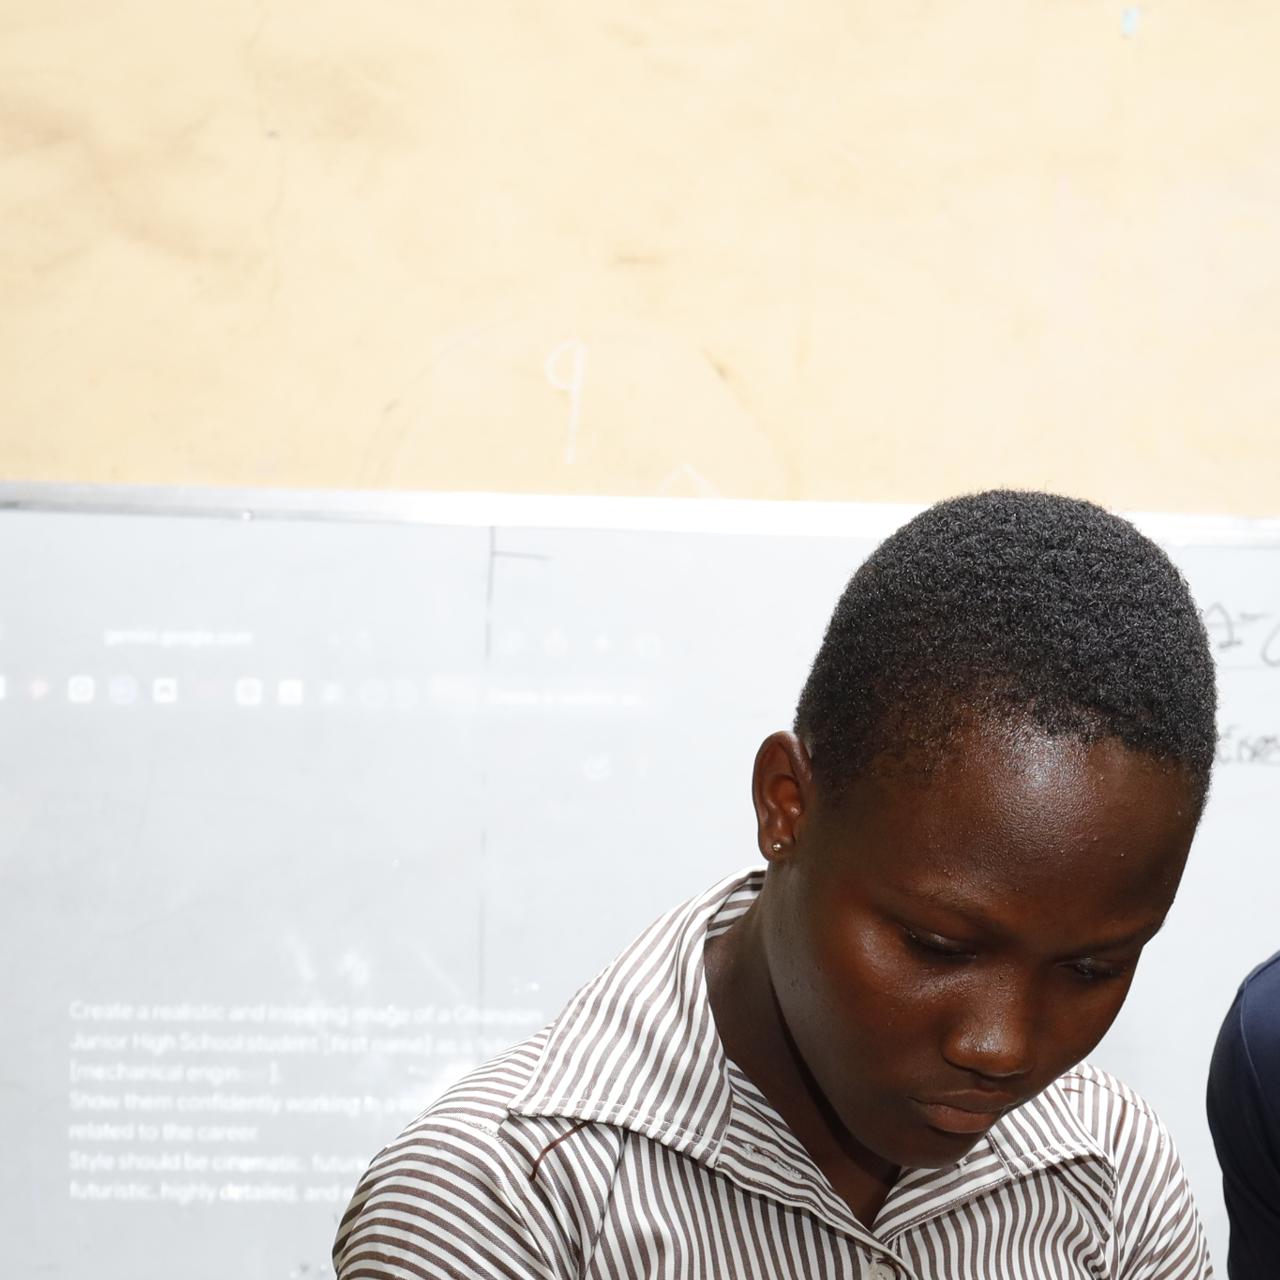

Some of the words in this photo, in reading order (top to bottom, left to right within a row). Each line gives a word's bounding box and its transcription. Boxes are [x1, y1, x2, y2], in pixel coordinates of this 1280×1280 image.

[69, 1000, 134, 1022] Create
[136, 1005, 150, 1021] a
[229, 1003, 265, 1023] and
[68, 1032, 128, 1051] Junior
[132, 1032, 179, 1056] High
[180, 1032, 243, 1053] School
[69, 1089, 121, 1111] Show
[123, 1090, 174, 1112] them
[176, 1090, 282, 1117] confidently
[68, 1120, 135, 1142] related
[138, 1122, 160, 1142] to
[162, 1122, 194, 1142] the
[69, 1149, 116, 1173] Style
[118, 1152, 181, 1172] should
[182, 1151, 209, 1173] be
[160, 1180, 218, 1207] highly
